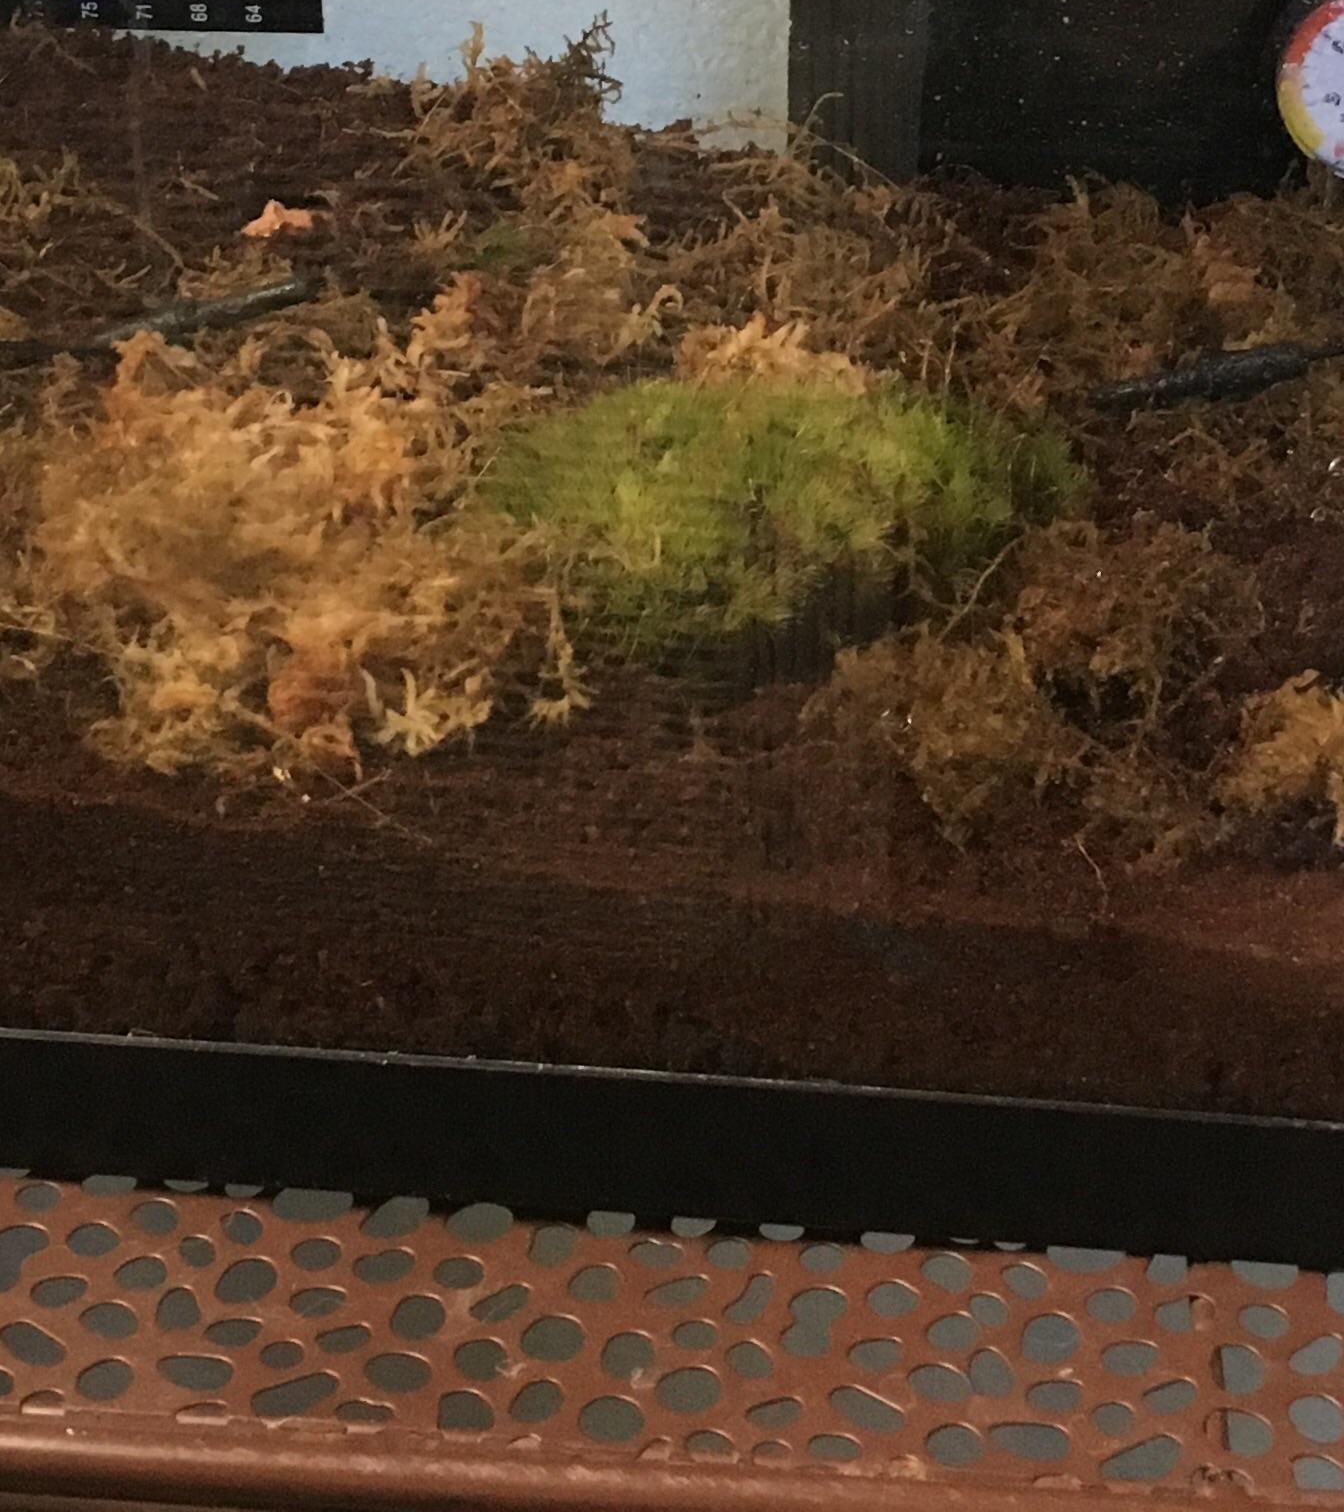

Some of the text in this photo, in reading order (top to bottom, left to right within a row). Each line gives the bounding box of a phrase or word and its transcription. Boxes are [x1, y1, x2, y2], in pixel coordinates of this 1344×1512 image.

[80, 1, 100, 20] 75
[135, 4, 154, 20] 71
[190, 3, 208, 23] 68
[245, 4, 263, 23] 64
